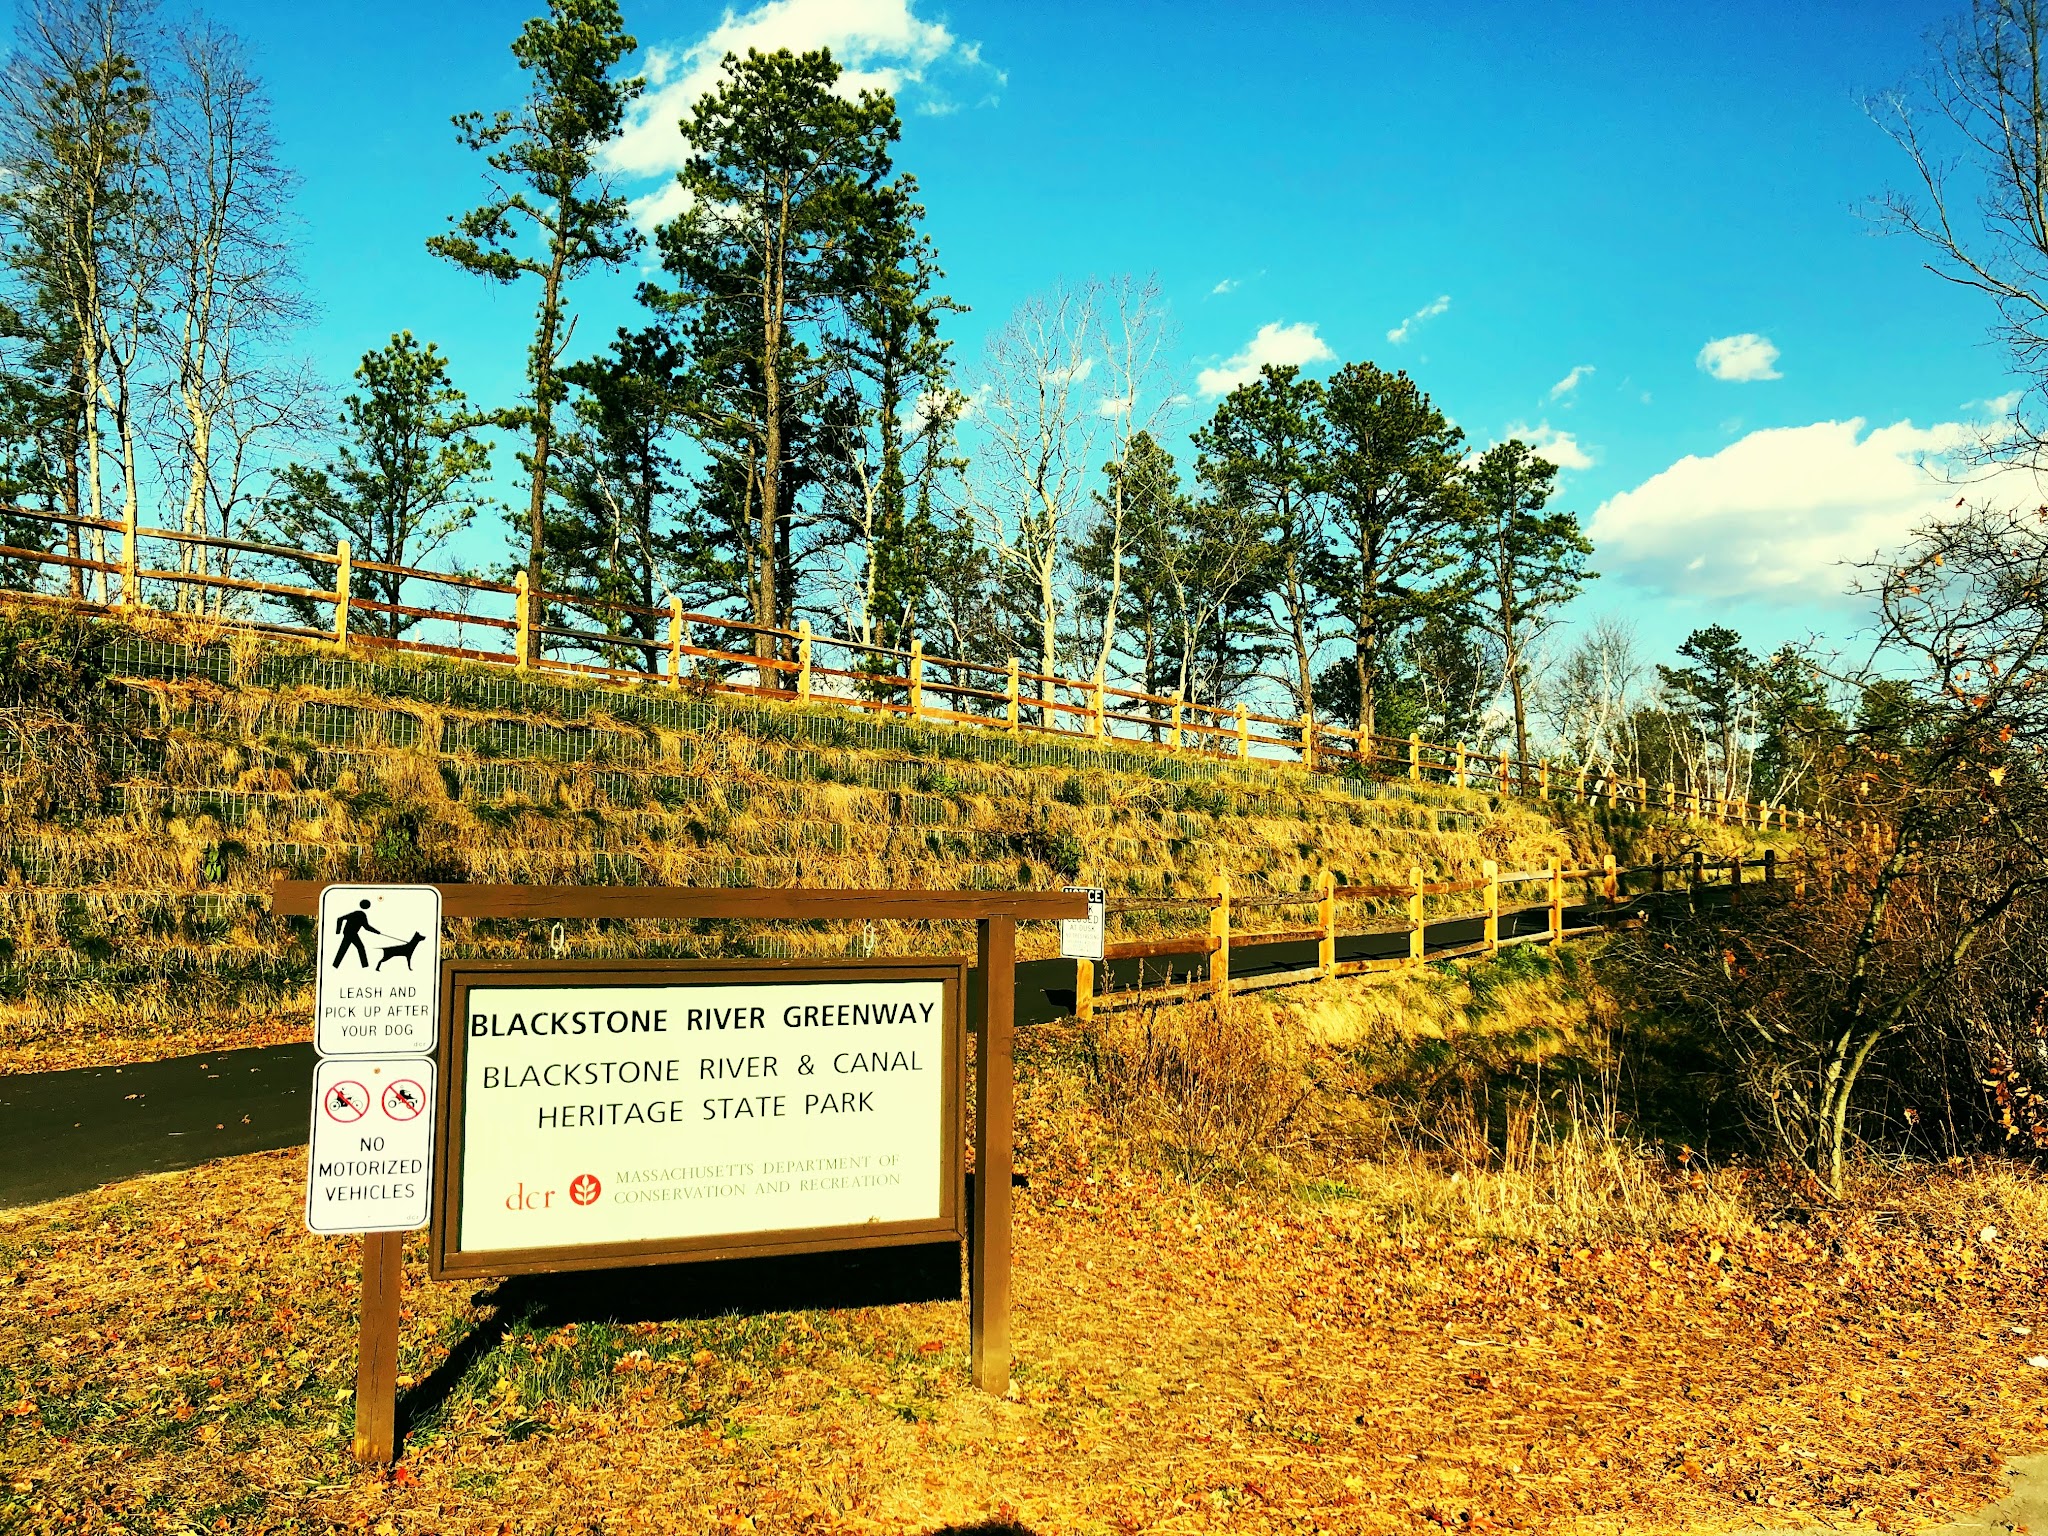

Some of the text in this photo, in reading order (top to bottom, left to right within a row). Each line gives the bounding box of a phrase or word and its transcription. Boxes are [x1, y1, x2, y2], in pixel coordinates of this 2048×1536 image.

[339, 986, 416, 999] LEASH AND
[325, 1005, 429, 1018] PICK UP AFTER
[471, 1002, 934, 1037] BLACKSTONE RIVER GREENWAY
[341, 1023, 413, 1037] YOUR DOG
[483, 1050, 923, 1089] BLACKSTONE RIVER & CANAL
[538, 1091, 874, 1129] HERITAGE STATE PARK
[360, 1136, 385, 1152] NO
[319, 1159, 422, 1177] MOTORIZED
[616, 1154, 900, 1184] MASSACHUSETTS DEPARTMENT OF
[325, 1183, 415, 1202] VEHICLES
[505, 1182, 556, 1211] dcr
[614, 1173, 900, 1204] CONSERVATION AND RECREATION
